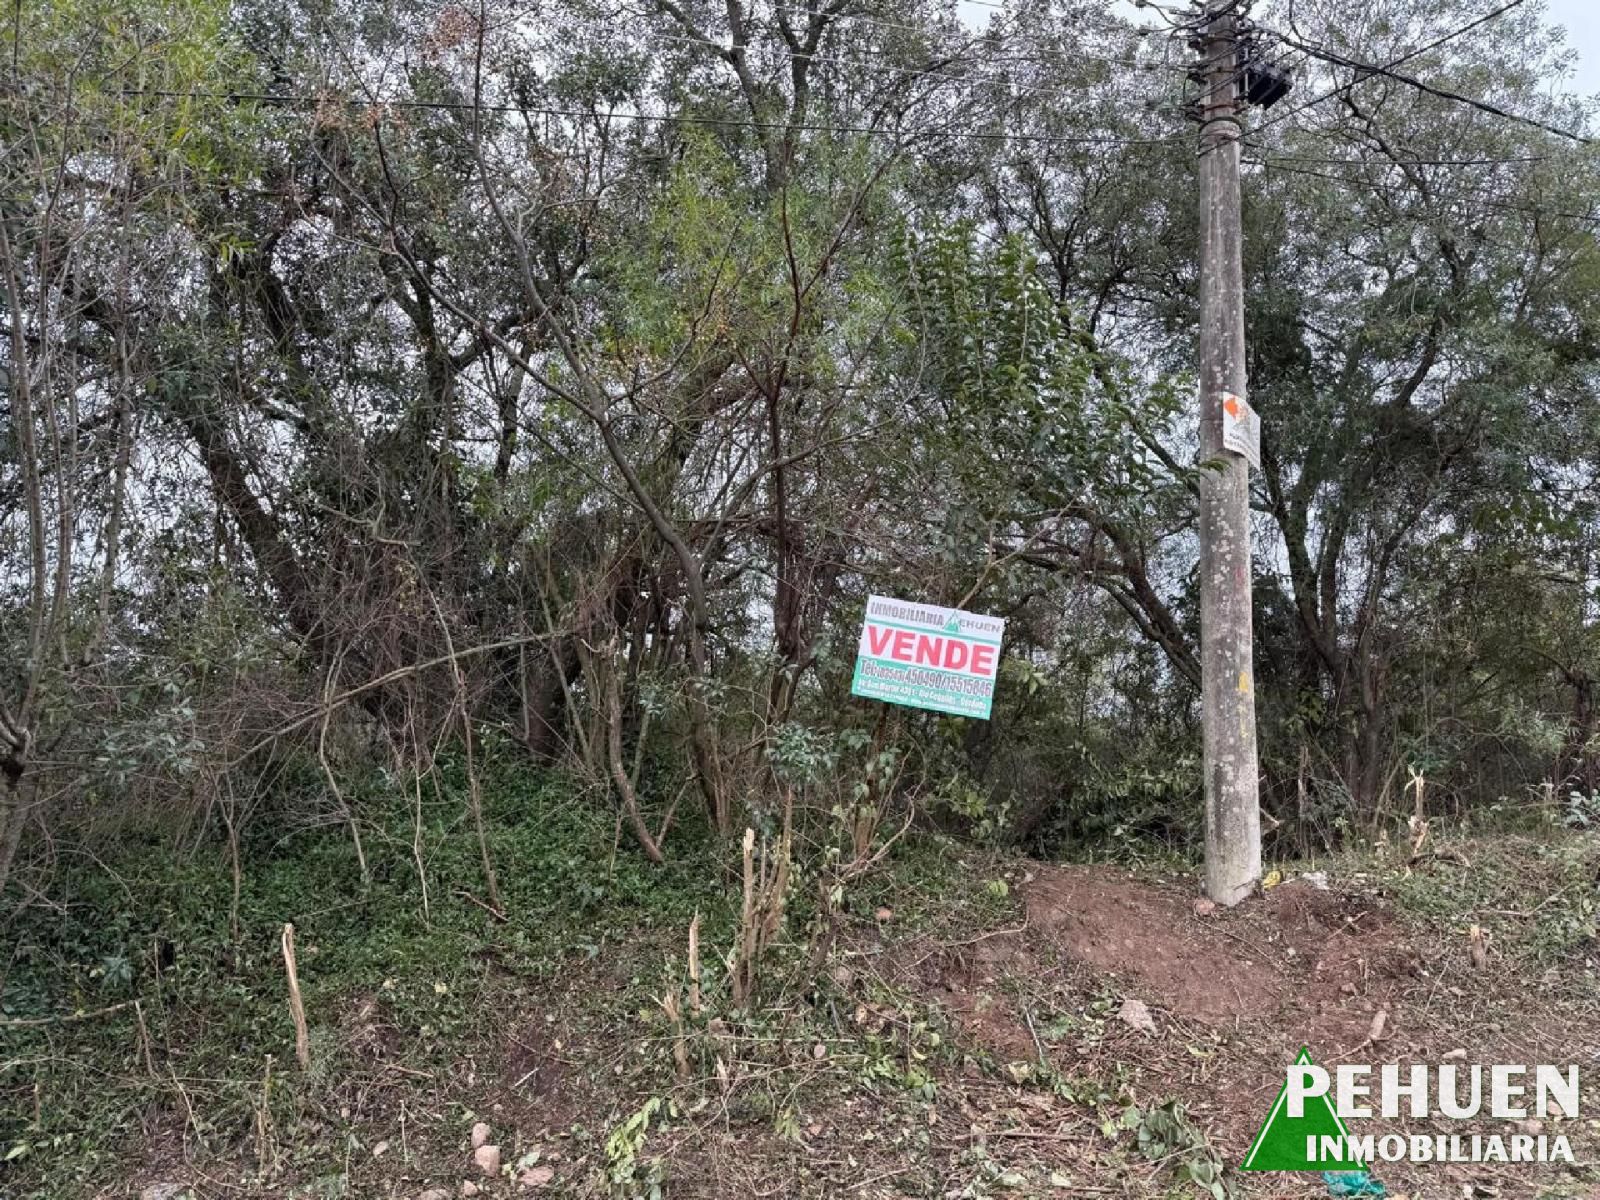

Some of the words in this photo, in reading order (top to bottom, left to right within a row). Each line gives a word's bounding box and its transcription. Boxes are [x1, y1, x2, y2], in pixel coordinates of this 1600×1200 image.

[870, 602, 944, 626] INMOBILIARIA
[953, 617, 1001, 633] EHUEN
[867, 625, 995, 676] VENDE
